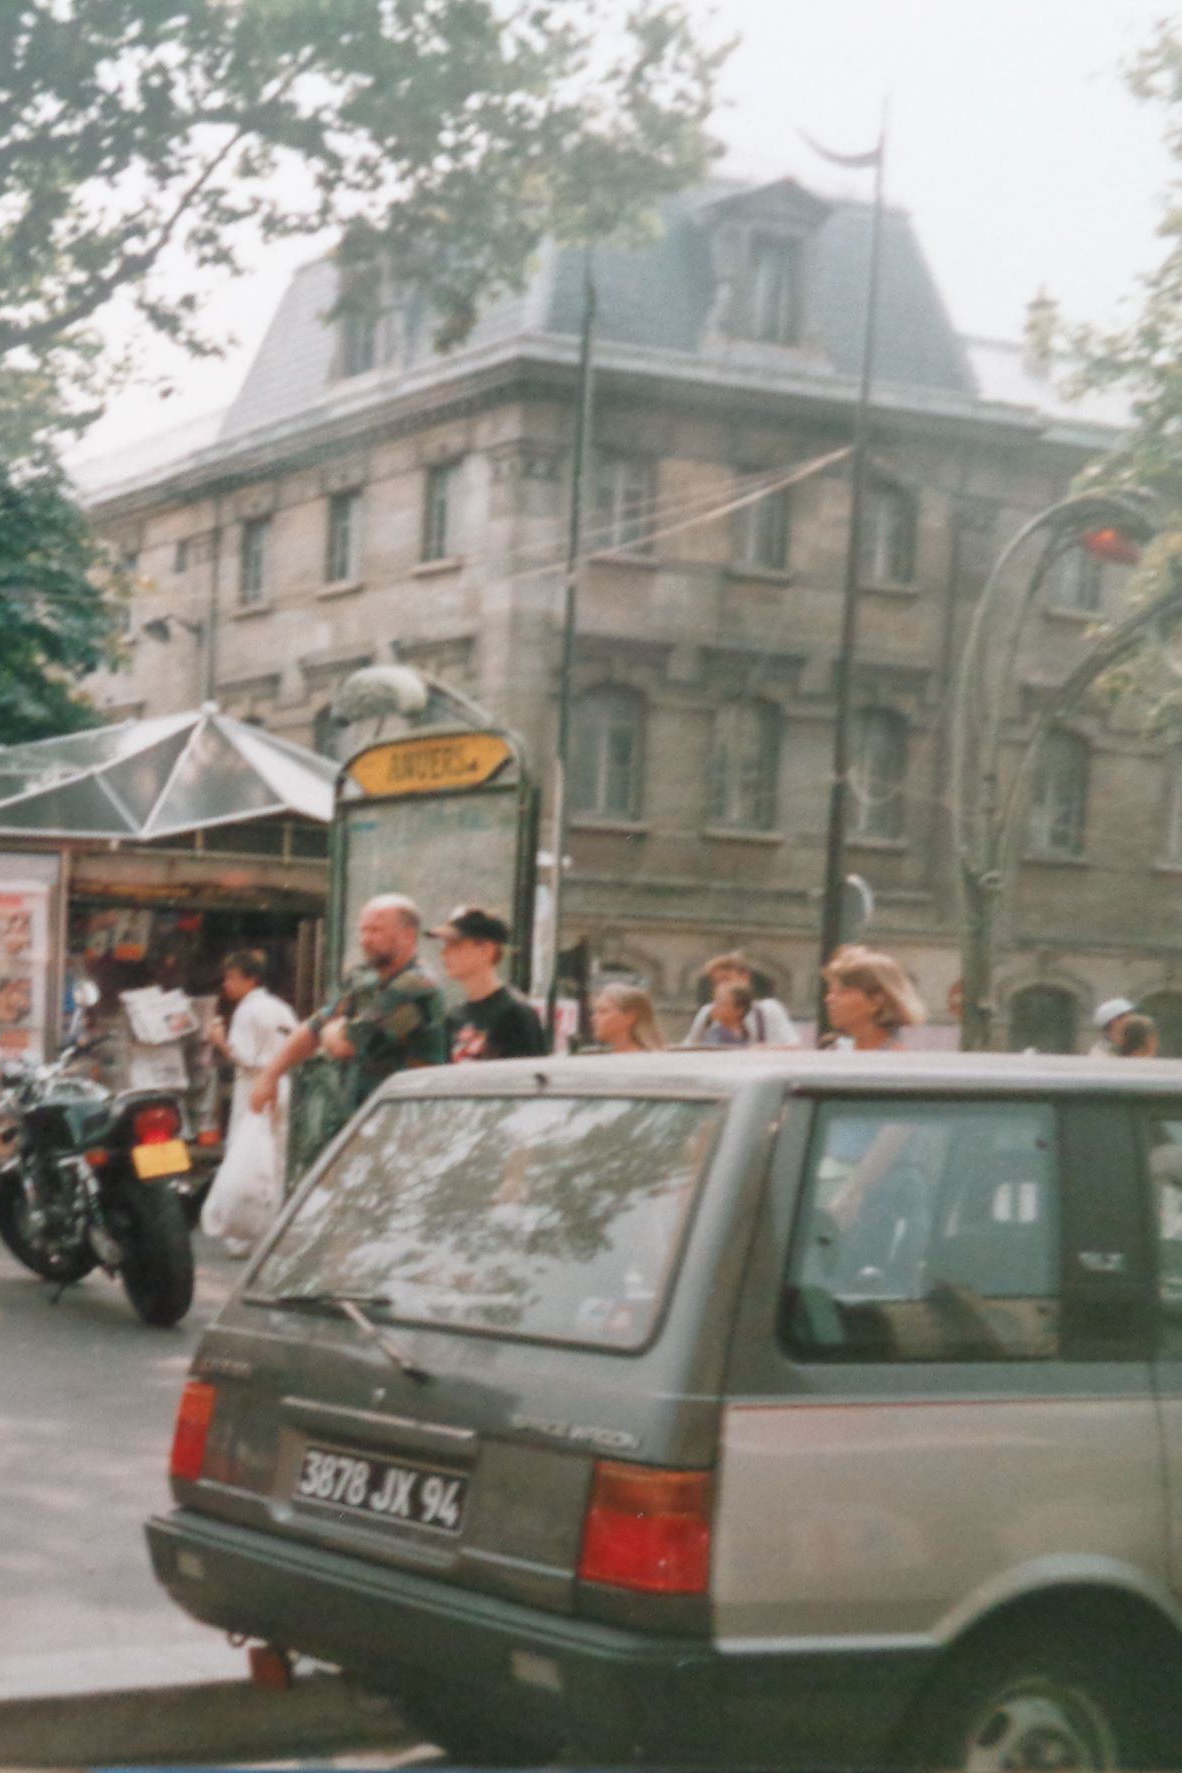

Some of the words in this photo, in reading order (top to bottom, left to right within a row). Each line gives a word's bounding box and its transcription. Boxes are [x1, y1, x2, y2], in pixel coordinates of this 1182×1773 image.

[300, 1450, 369, 1506] 3878
[370, 1467, 416, 1518] JX
[420, 1476, 460, 1528] 94
